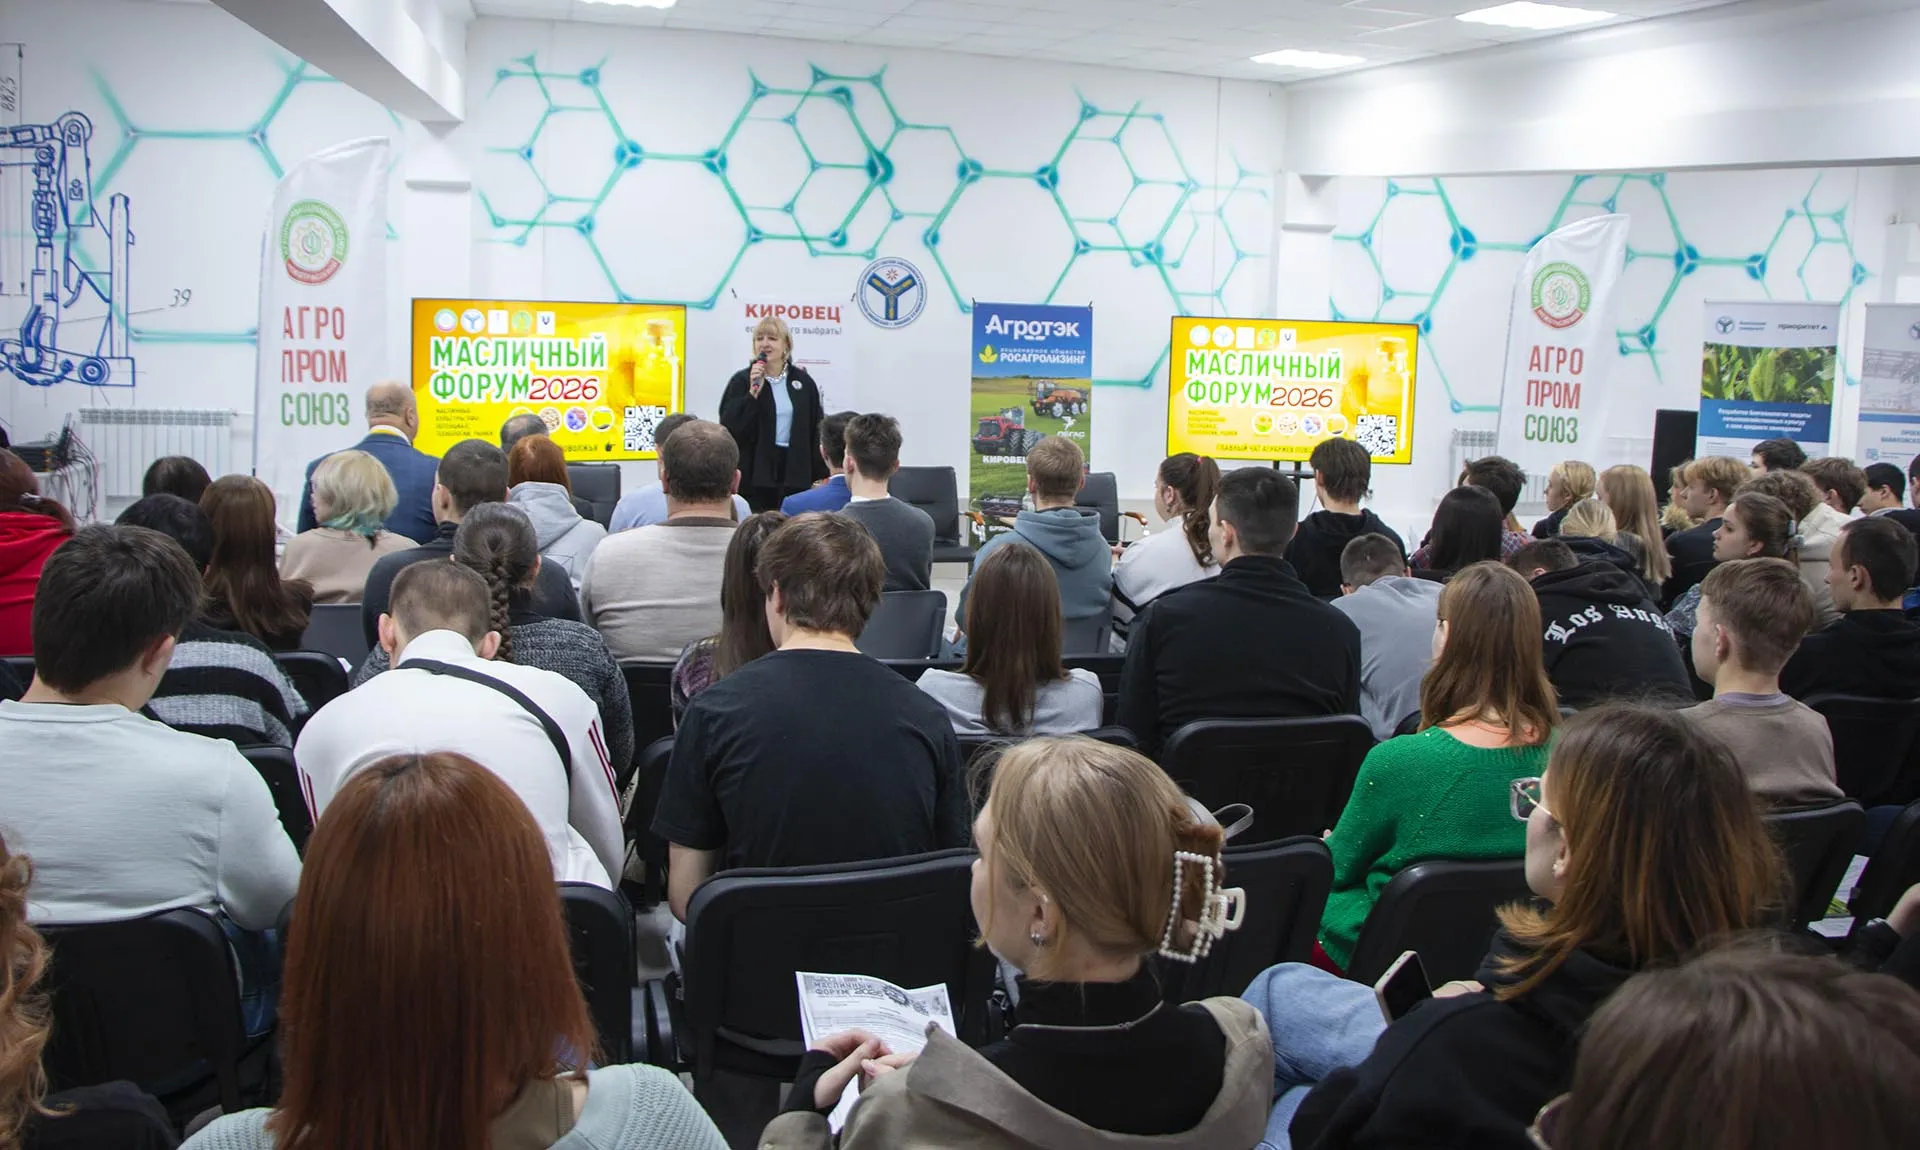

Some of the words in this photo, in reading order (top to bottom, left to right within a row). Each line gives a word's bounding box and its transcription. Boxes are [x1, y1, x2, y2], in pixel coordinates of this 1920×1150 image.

[168, 288, 192, 308] 39
[283, 307, 345, 341] АГРО
[745, 303, 841, 323] КИРОВЕЦ
[985, 314, 1080, 341] Агротэк
[281, 350, 347, 383] ПРОМ
[433, 336, 605, 368] МАСЛИЧНЫЙ
[1000, 353, 1086, 364] РОСАГРОЛИЗИНГ
[1188, 351, 1341, 379] МАСЛИЧНЫЙ
[1529, 345, 1584, 375] АГРО
[433, 372, 529, 400] ФОРУМ
[529, 378, 598, 400] 2026
[1187, 380, 1271, 404] ФОРУМ
[1271, 387, 1333, 407] 2026
[1526, 380, 1581, 409] ПРОМ
[281, 393, 350, 427] СОЮЗ
[1524, 414, 1578, 443] СОЮЗ
[1544, 605, 1604, 644] Los
